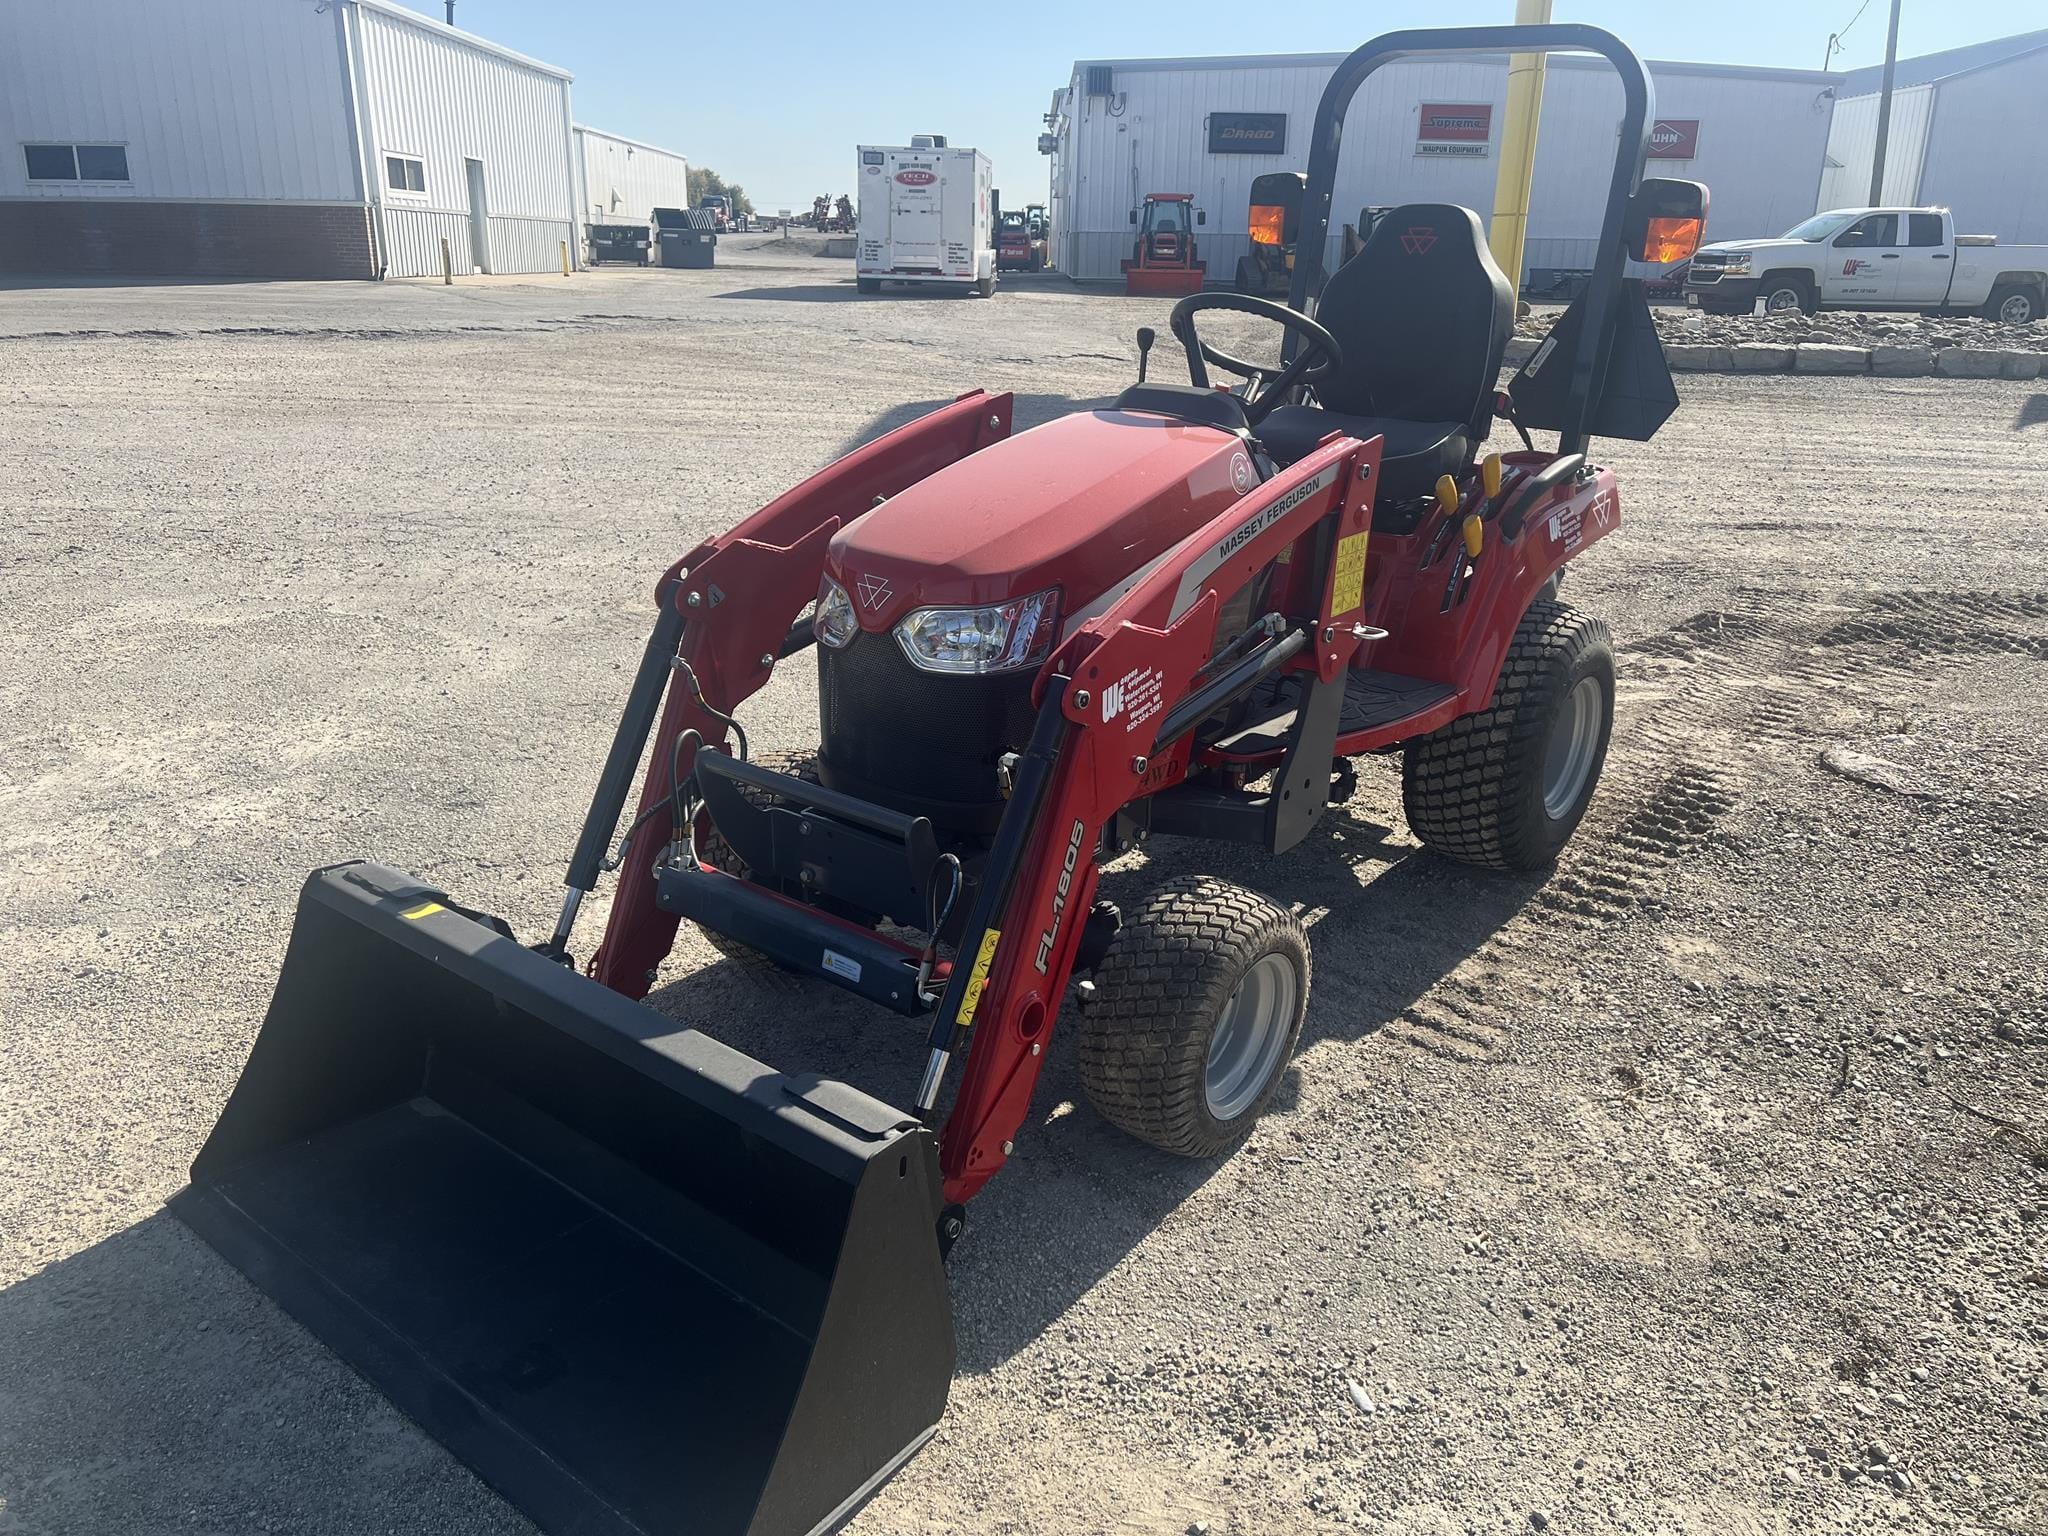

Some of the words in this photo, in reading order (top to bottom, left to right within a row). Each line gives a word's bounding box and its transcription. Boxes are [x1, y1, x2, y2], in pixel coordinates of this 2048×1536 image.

[1425, 116, 1482, 129] Supreme
[1221, 127, 1276, 139] DRAGO
[1652, 133, 1678, 143] UHN
[1422, 145, 1448, 153] WAUPUN
[1448, 145, 1483, 154] EQUIPMENT
[1219, 515, 1264, 559] MASSEY
[1267, 477, 1320, 523] FERGUSON
[1102, 681, 1125, 723] WE
